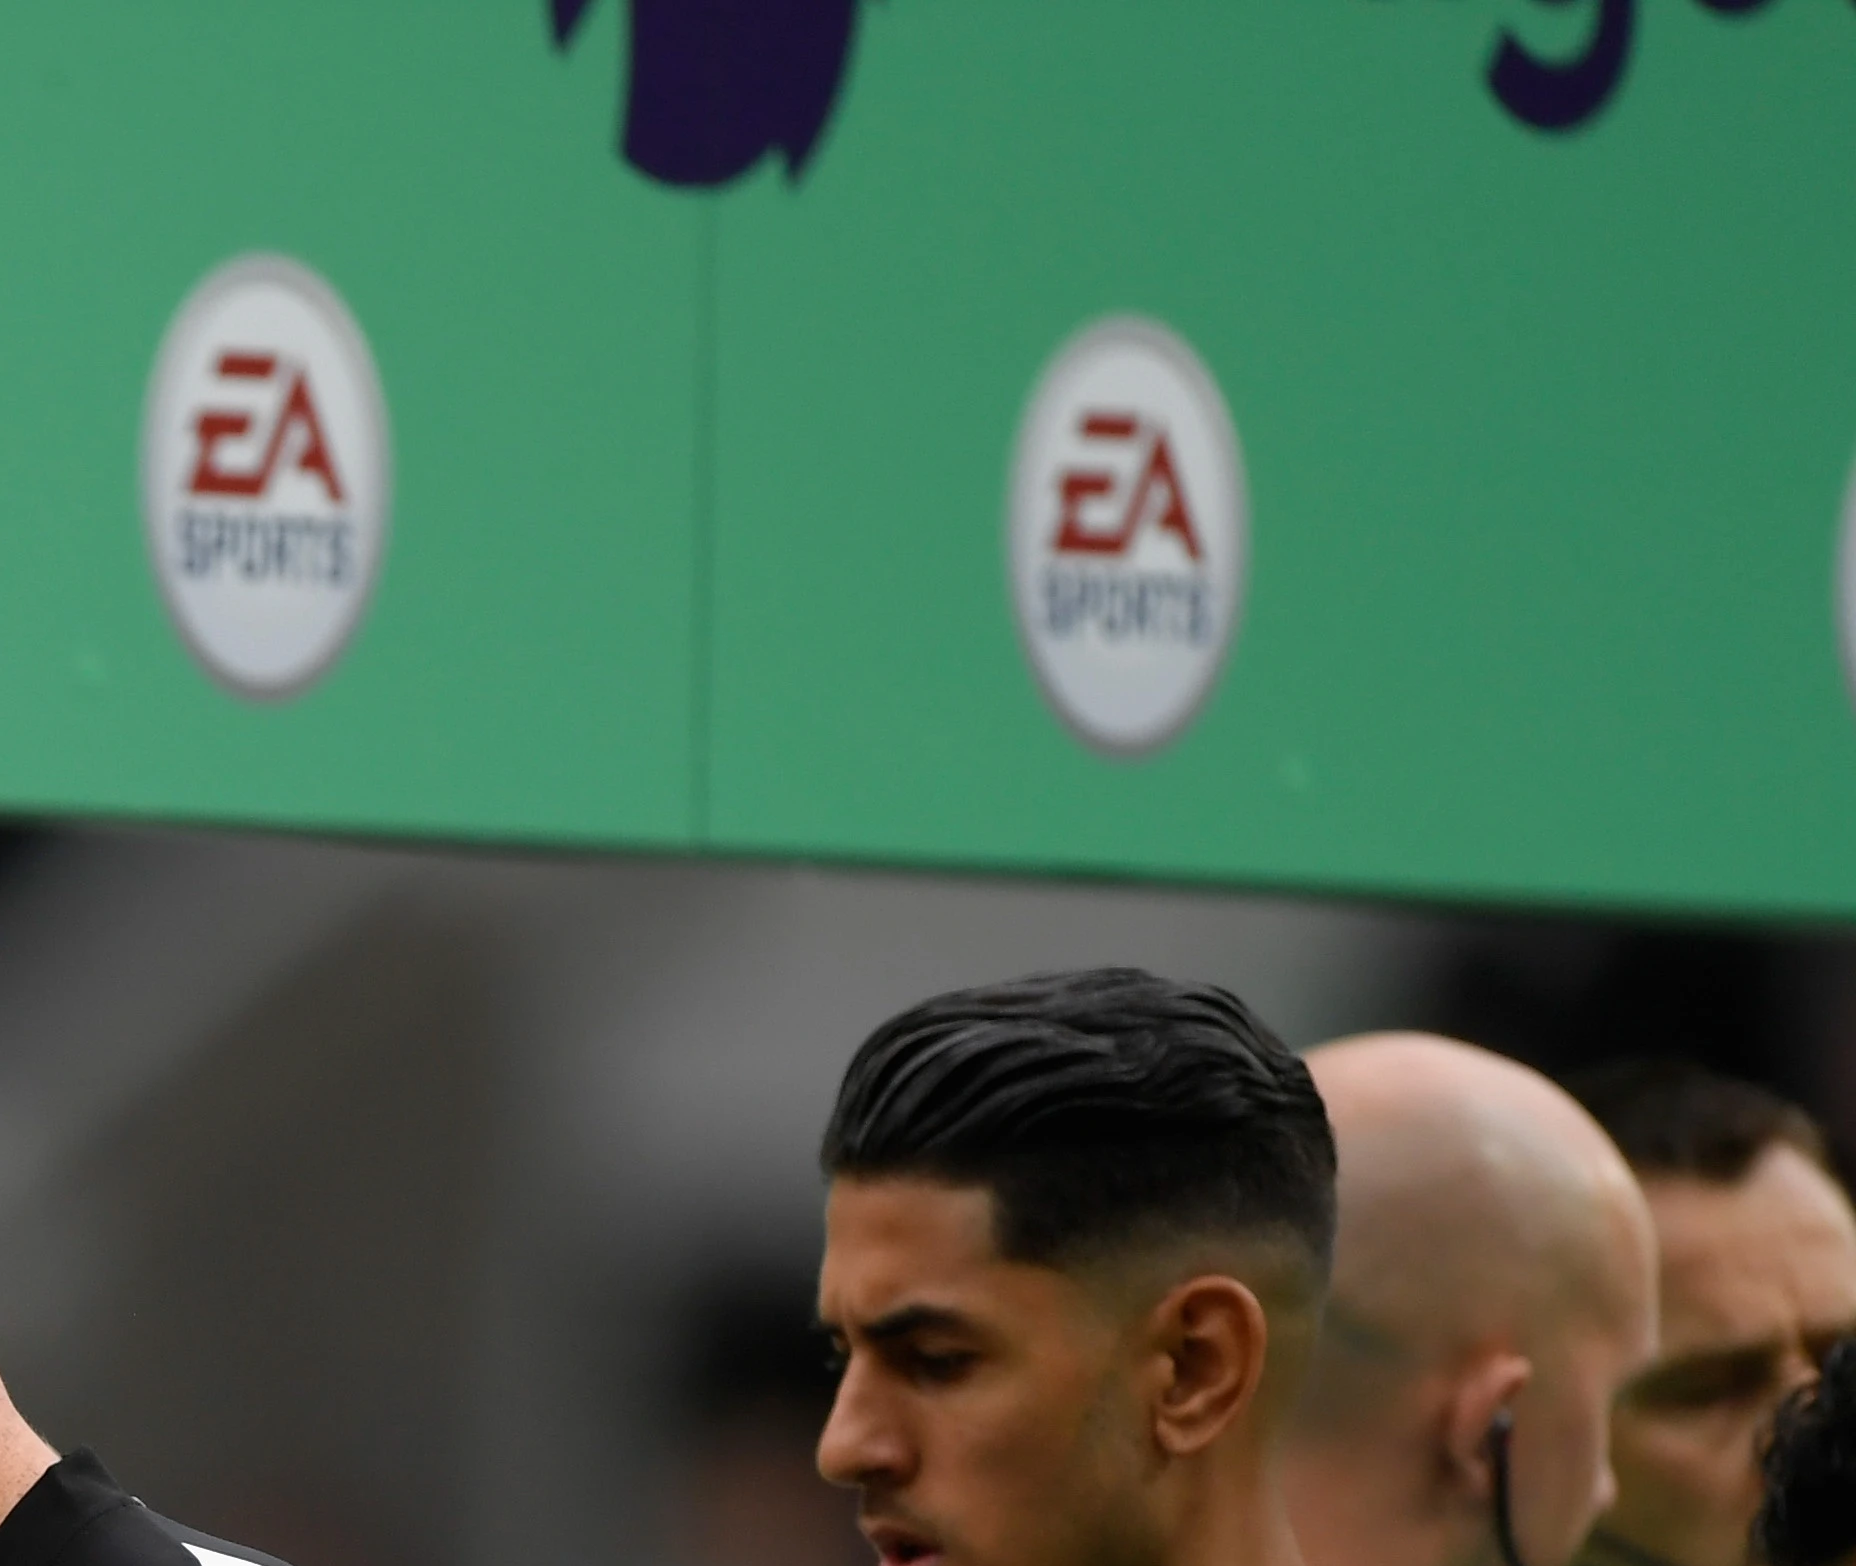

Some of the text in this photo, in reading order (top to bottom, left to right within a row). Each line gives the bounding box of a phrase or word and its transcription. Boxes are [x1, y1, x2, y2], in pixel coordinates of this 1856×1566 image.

[188, 352, 347, 507] EA
[1052, 412, 1203, 563] EA
[178, 512, 354, 586] SPORTS
[1041, 568, 1212, 646] SPORTS
